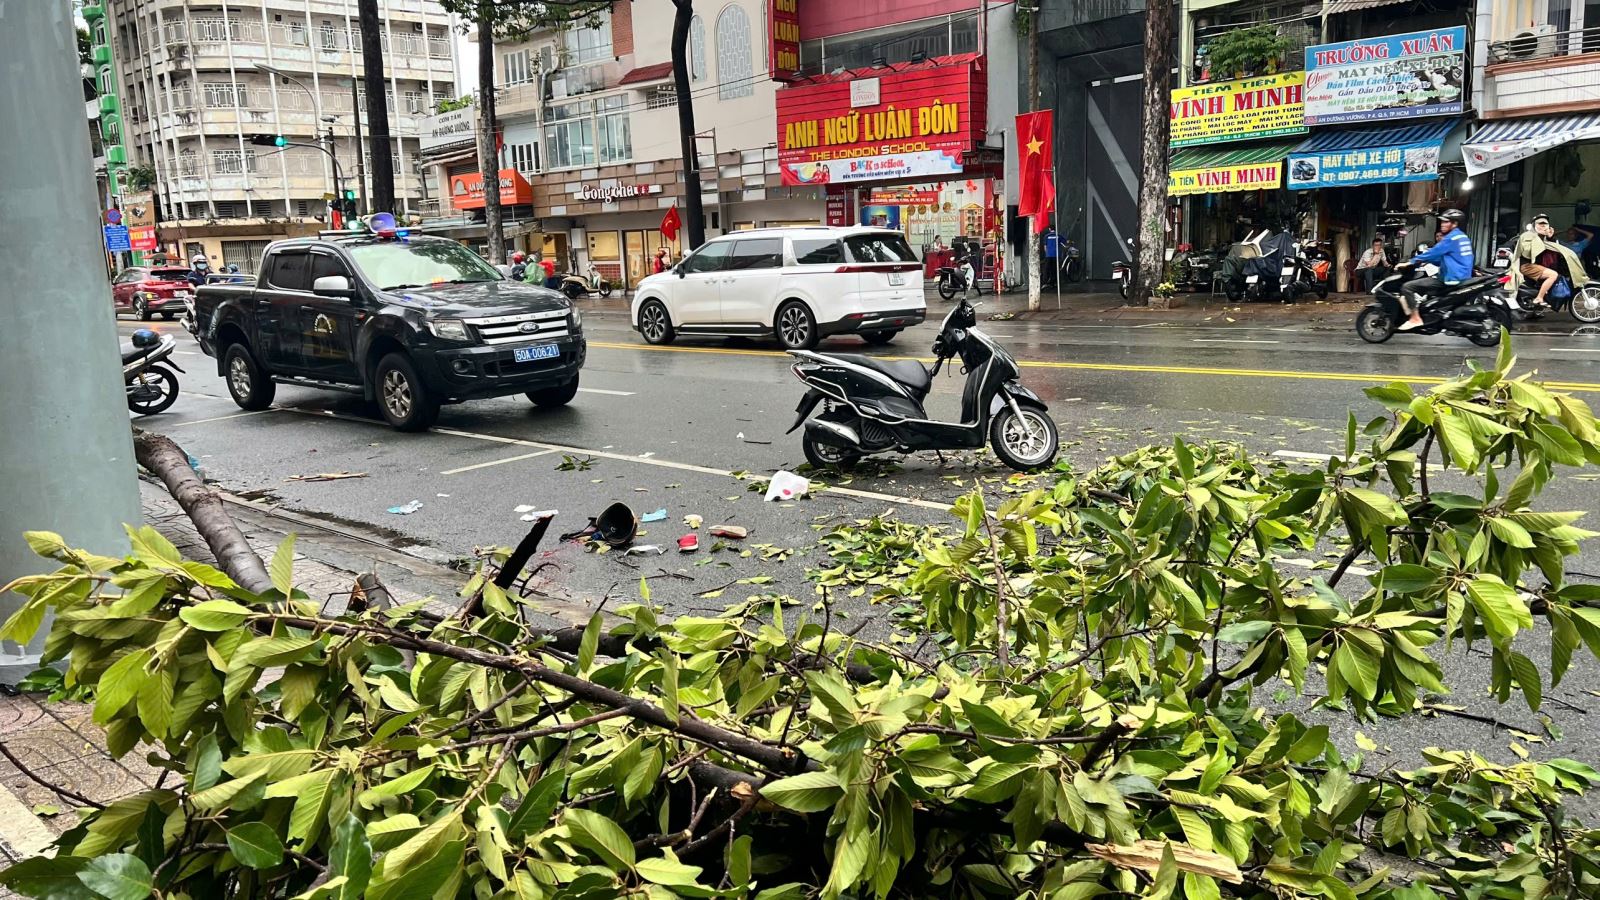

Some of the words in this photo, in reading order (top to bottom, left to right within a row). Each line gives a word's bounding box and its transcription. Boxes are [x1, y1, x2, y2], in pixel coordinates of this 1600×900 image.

[1315, 42, 1388, 65] TRƯỜNG
[1400, 33, 1453, 56] XUÂN
[1338, 67, 1369, 79] MAY
[1409, 60, 1428, 71] XE
[1376, 85, 1394, 93] DVD
[1171, 96, 1224, 119] VĨNH
[1234, 85, 1303, 111] MINH
[785, 119, 818, 150] ANH
[825, 108, 860, 145] NGỮ
[864, 105, 912, 141] LUÂN
[918, 99, 958, 136] ĐÔN
[809, 150, 831, 161] THE
[833, 146, 878, 159] LONDON
[881, 141, 930, 156] SCHOOL
[1323, 154, 1342, 168] MAY
[1369, 151, 1382, 164] XE
[850, 160, 873, 172] BACK
[1197, 170, 1231, 186] VĨNH
[1236, 167, 1276, 183] MINH
